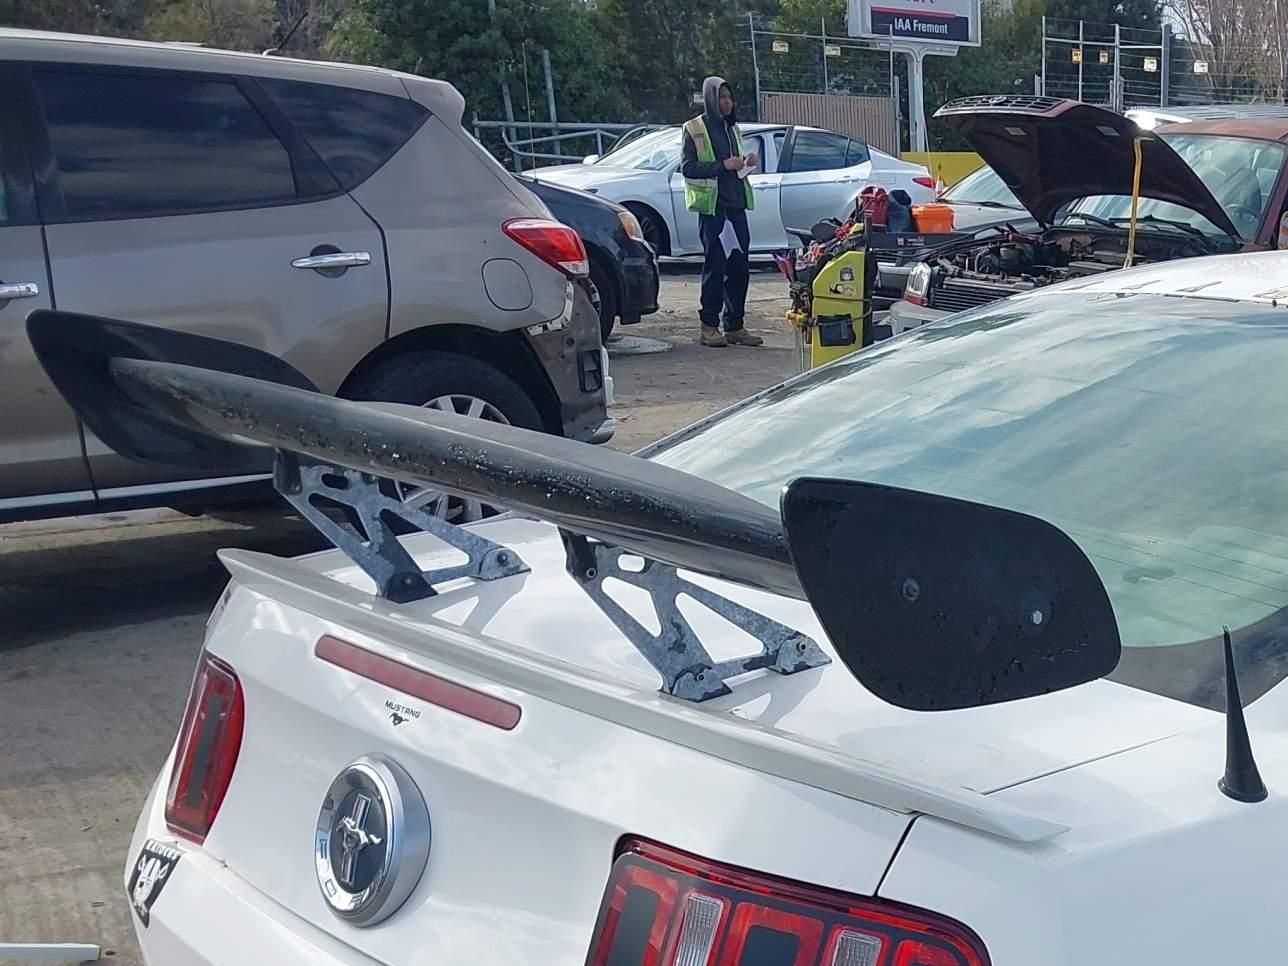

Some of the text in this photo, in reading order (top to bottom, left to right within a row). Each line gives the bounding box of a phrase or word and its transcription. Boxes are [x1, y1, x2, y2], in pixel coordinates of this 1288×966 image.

[894, 17, 948, 35] IAA Fremont
[385, 700, 421, 719] MUSTANG
